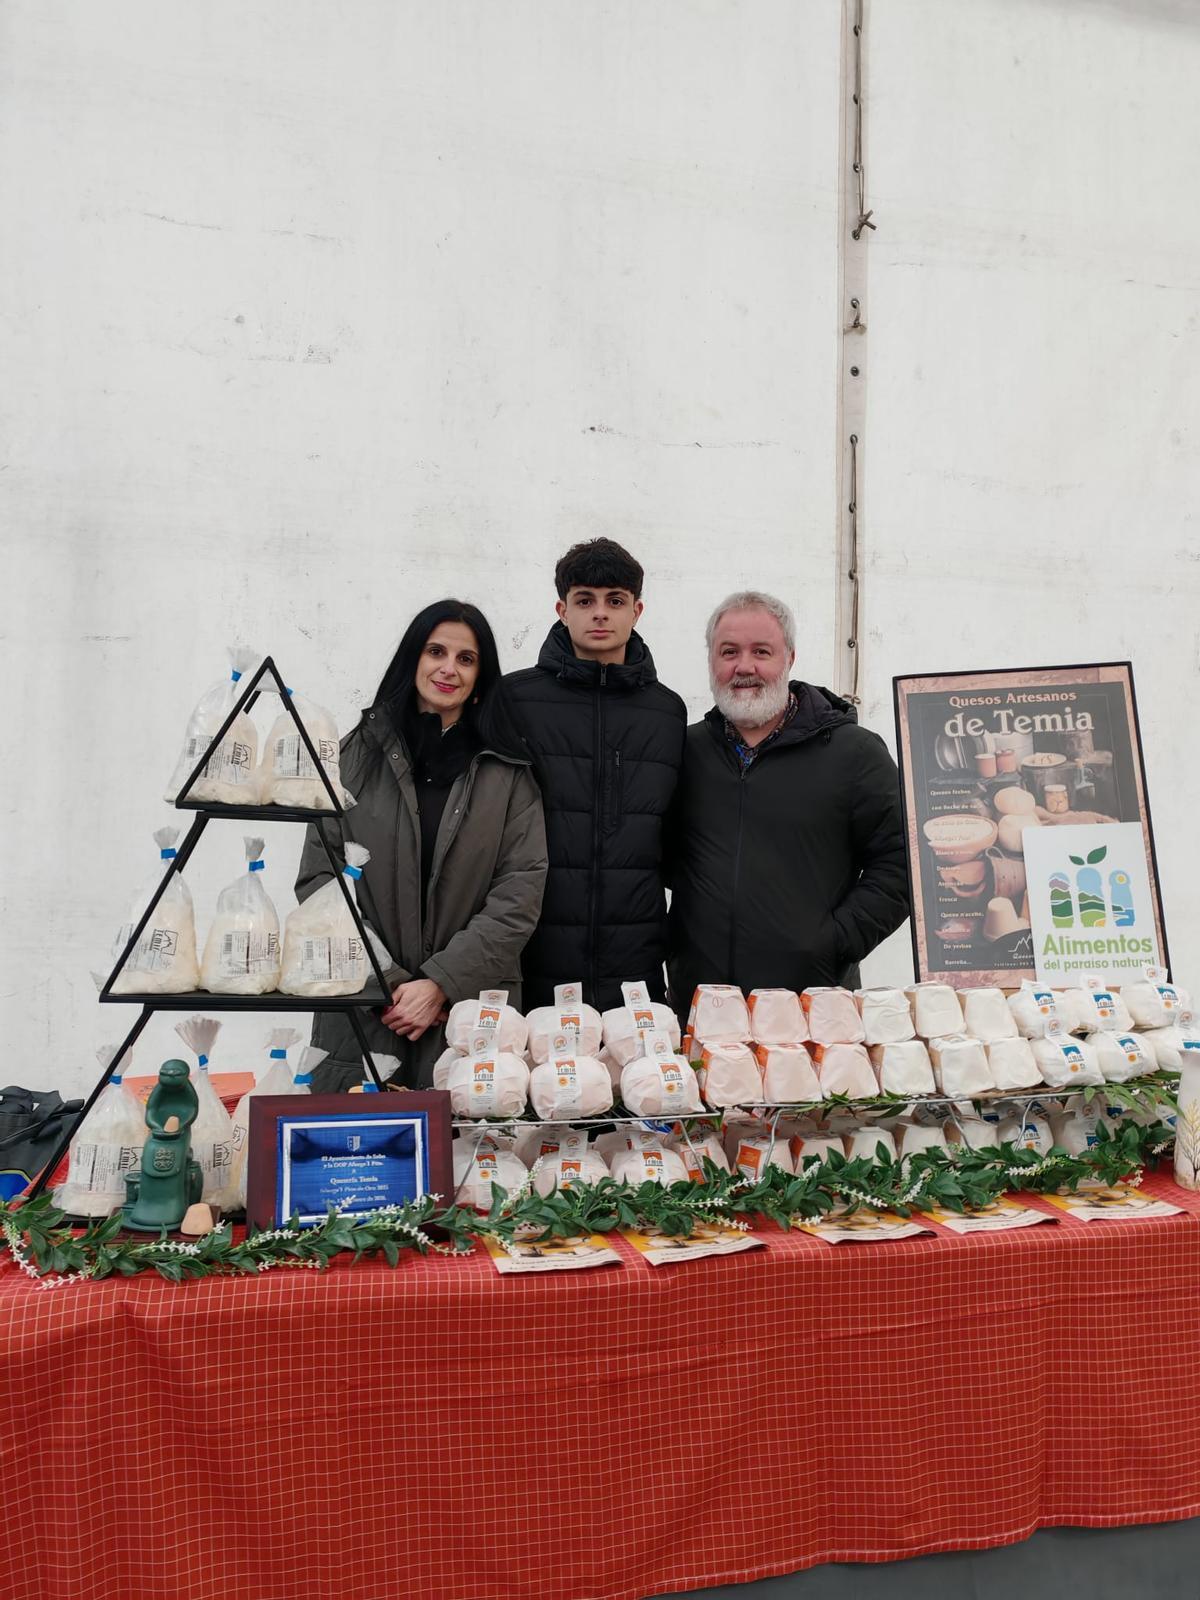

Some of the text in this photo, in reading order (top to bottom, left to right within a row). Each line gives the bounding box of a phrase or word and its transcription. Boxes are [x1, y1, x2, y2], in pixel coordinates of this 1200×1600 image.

[949, 691, 1077, 709] Quesos Artesanos
[944, 706, 1095, 738] de Temia
[1042, 933, 1153, 956] Alimentos
[1043, 958, 1060, 970] del
